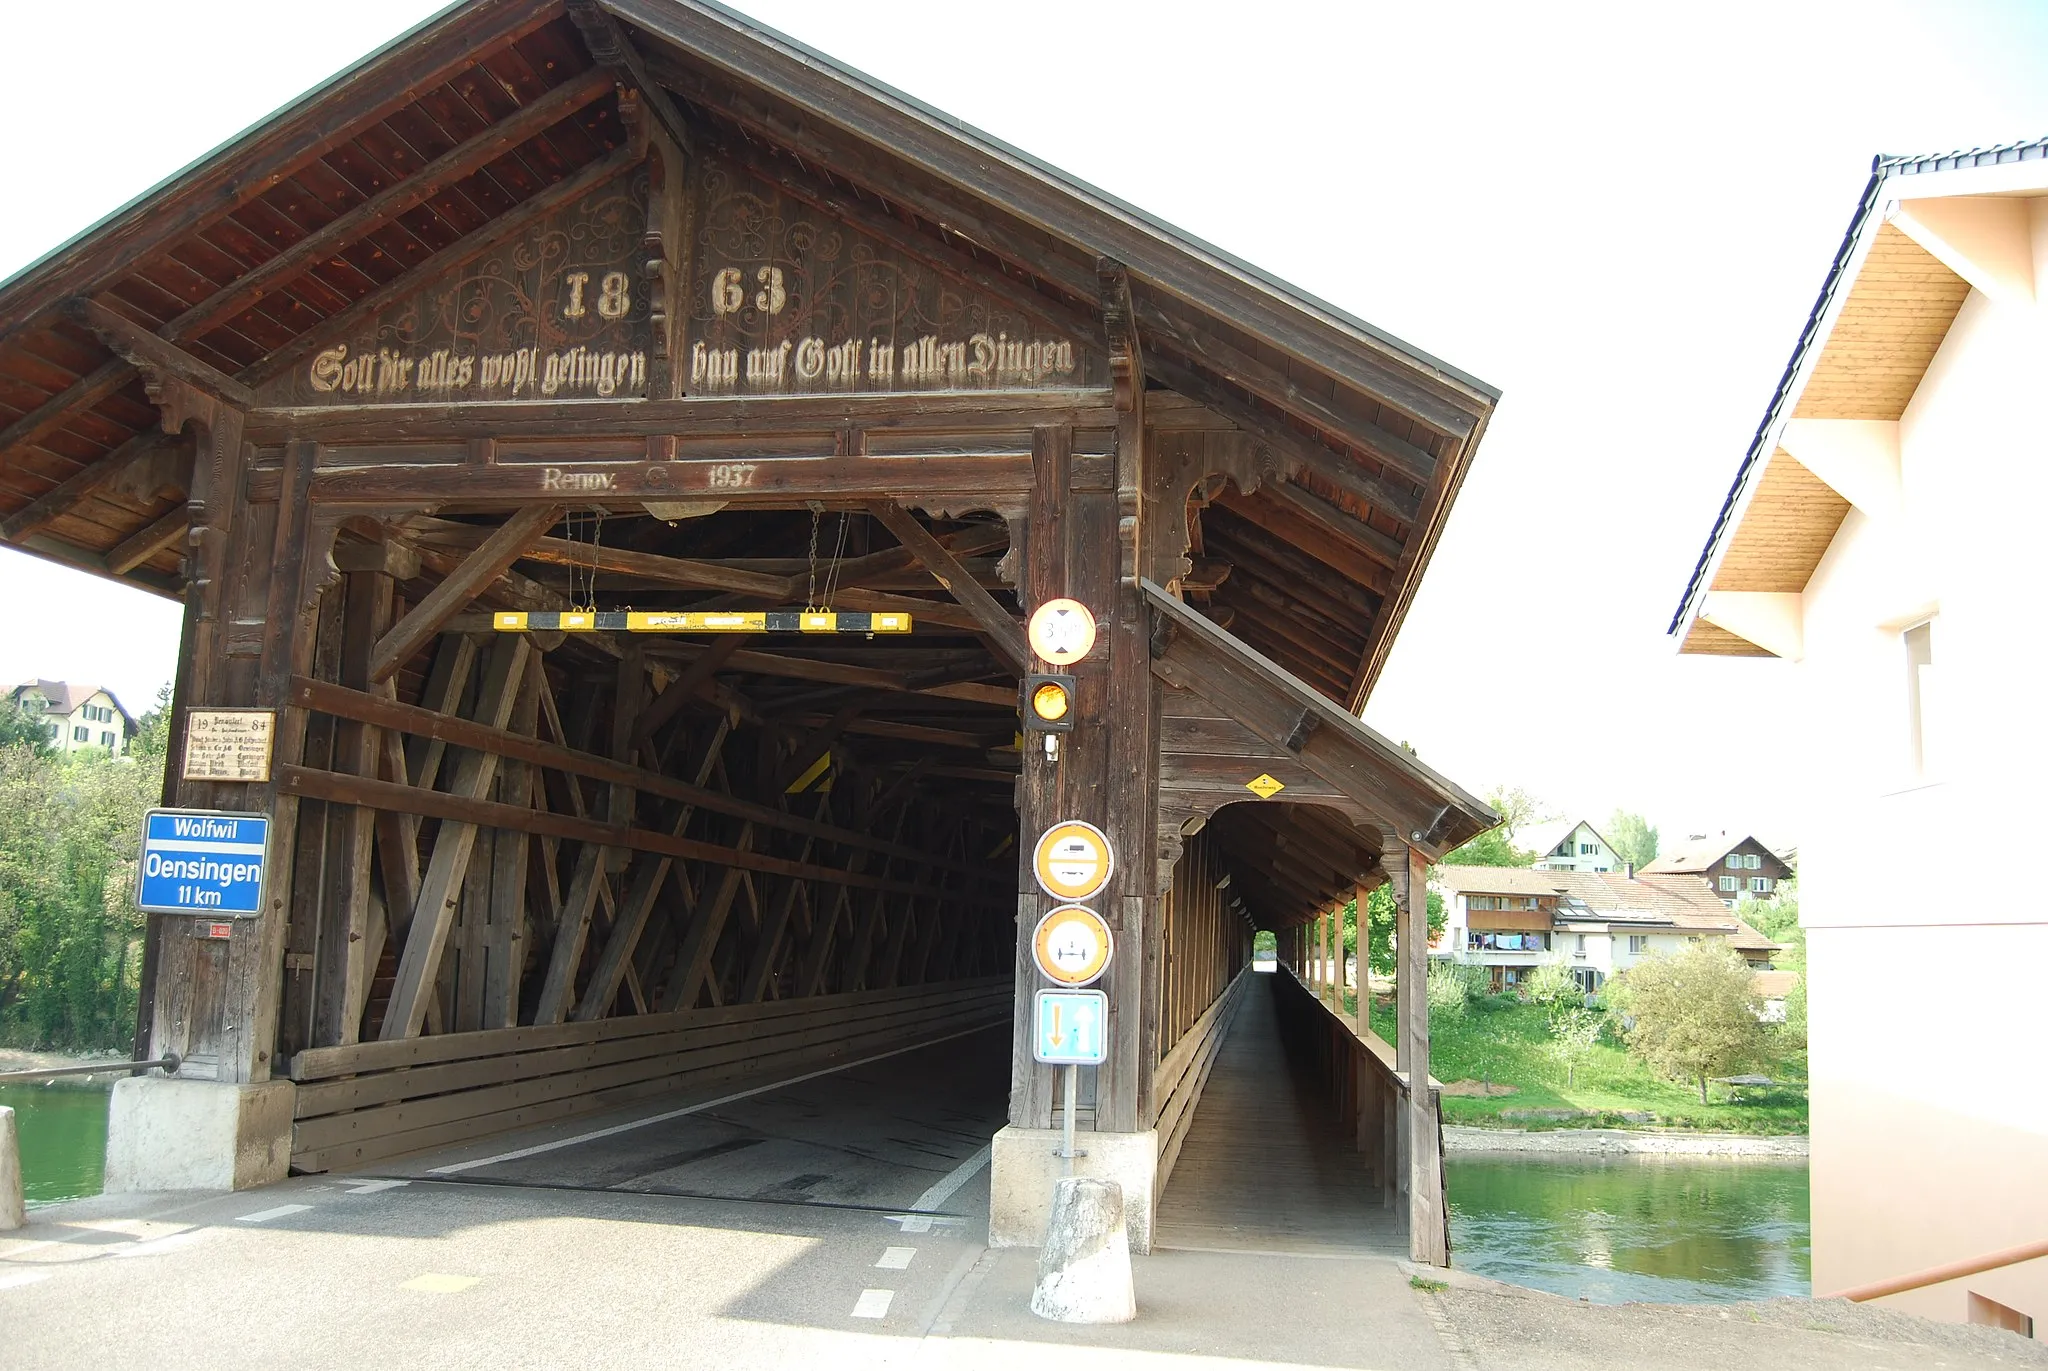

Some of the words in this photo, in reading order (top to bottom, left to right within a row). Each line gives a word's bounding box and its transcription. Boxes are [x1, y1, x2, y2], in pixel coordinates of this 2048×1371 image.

[563, 271, 629, 319] 18
[711, 266, 787, 315] 63
[310, 343, 376, 392] Soll
[416, 346, 477, 390] alles
[481, 346, 540, 395] wohl
[542, 345, 646, 396] gelingen
[746, 337, 793, 384] auf
[795, 337, 862, 380] Gott
[868, 337, 895, 379] in
[902, 334, 967, 377] allen
[968, 332, 1073, 381] Dingen
[542, 467, 618, 490] Renov.
[707, 464, 759, 488] 1937
[174, 818, 238, 839] Wolfwil
[145, 853, 261, 888] Oensingen
[178, 885, 192, 904] 11
[195, 886, 222, 905] km
